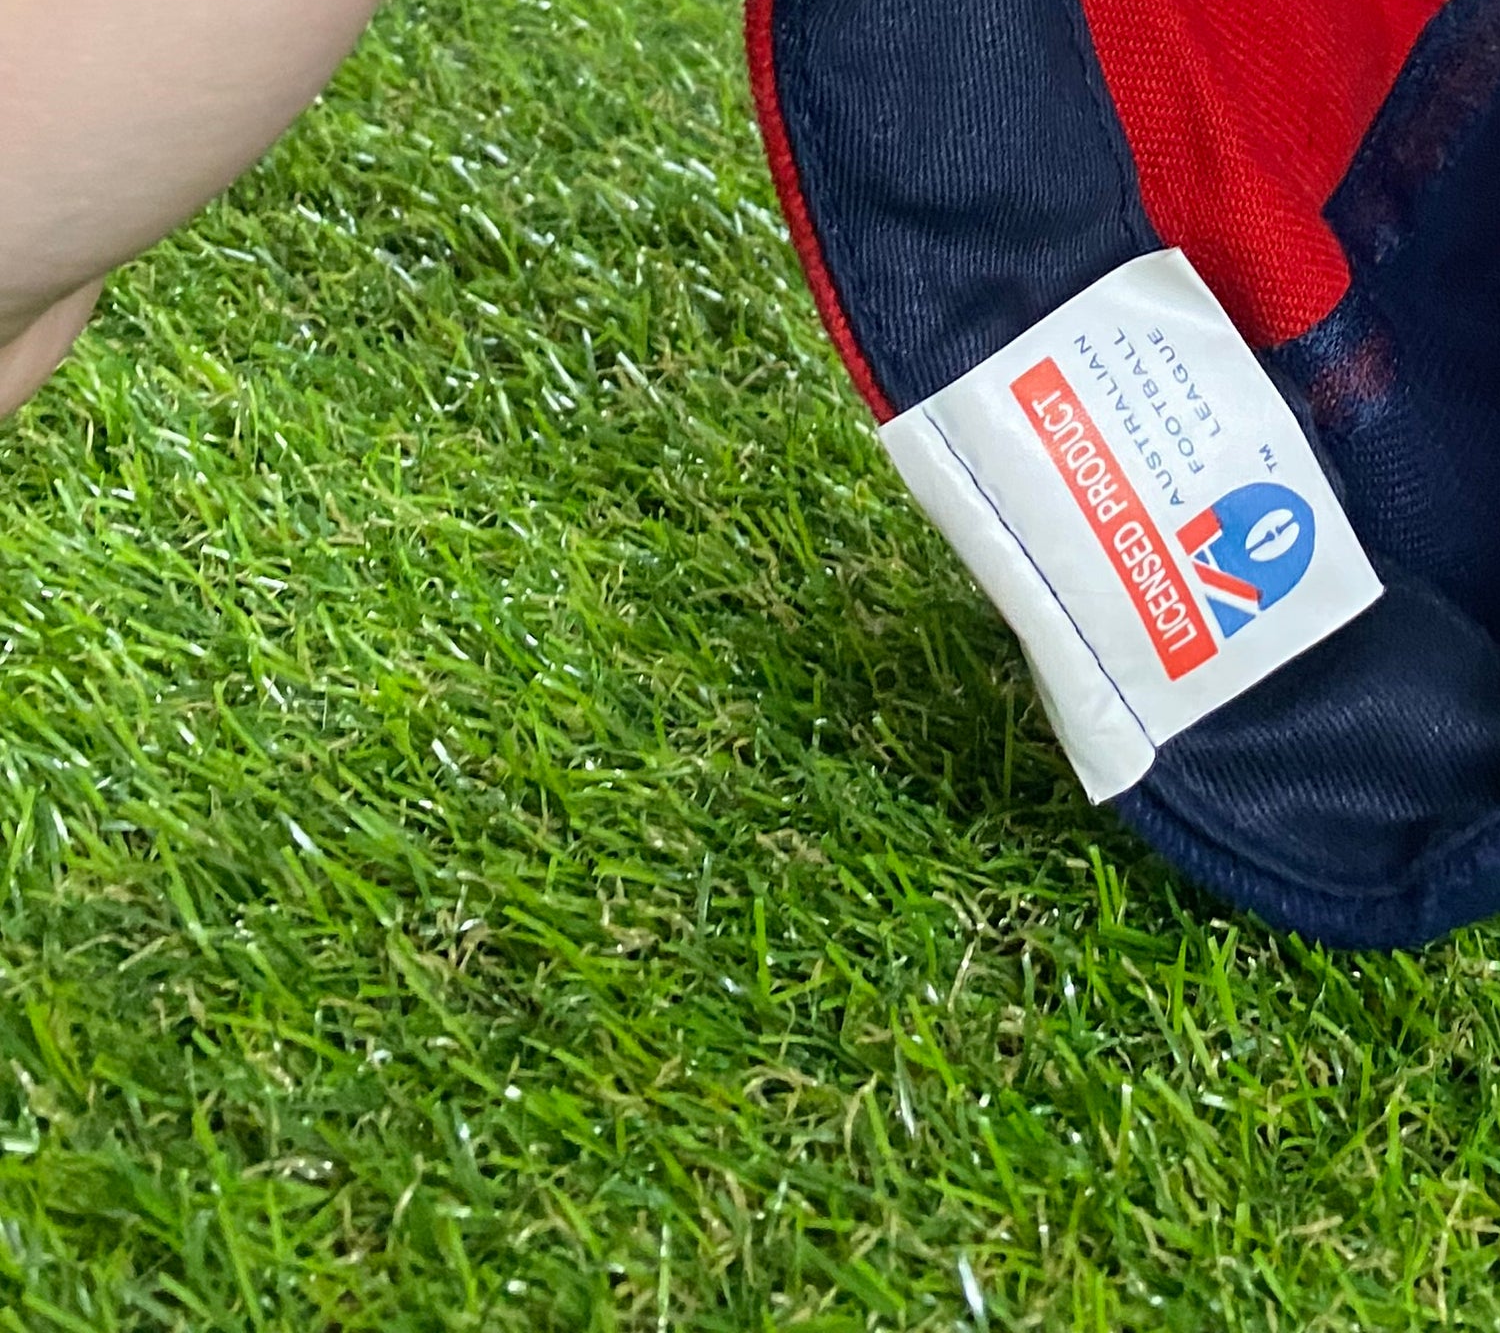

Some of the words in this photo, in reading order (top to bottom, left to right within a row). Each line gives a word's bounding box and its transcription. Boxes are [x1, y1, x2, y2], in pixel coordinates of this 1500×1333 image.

[1074, 335, 1184, 505] AUSTRALIAN
[1114, 327, 1204, 474] FOOTBALL
[1148, 327, 1221, 437] LEAGUE
[1032, 390, 1128, 523] PRODUCT
[1114, 521, 1197, 652] LICENSED
